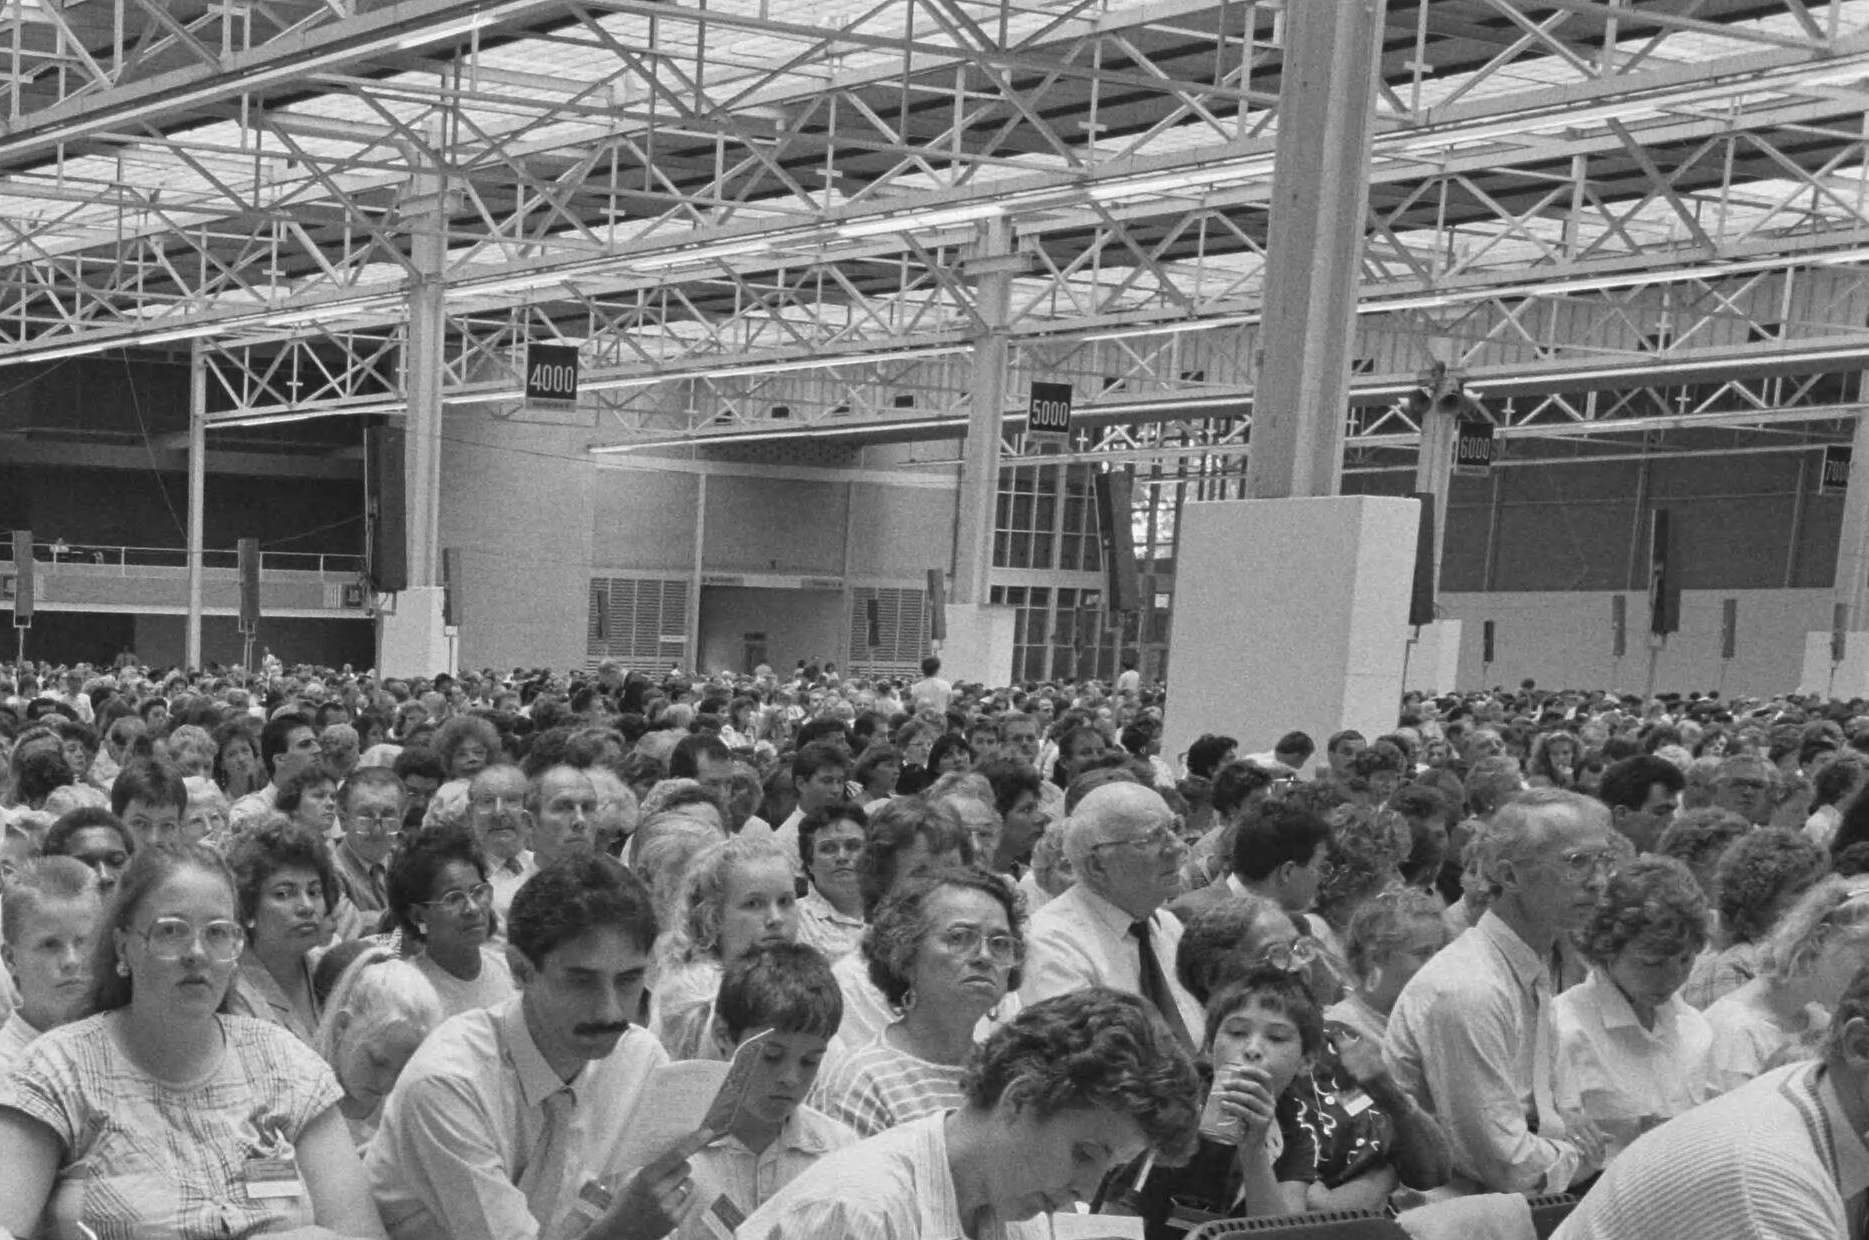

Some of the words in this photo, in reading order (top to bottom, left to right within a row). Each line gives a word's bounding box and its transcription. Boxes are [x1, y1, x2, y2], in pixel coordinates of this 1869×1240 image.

[530, 363, 574, 393] 4000
[1032, 399, 1068, 426] 5000
[1461, 436, 1490, 460] 6000
